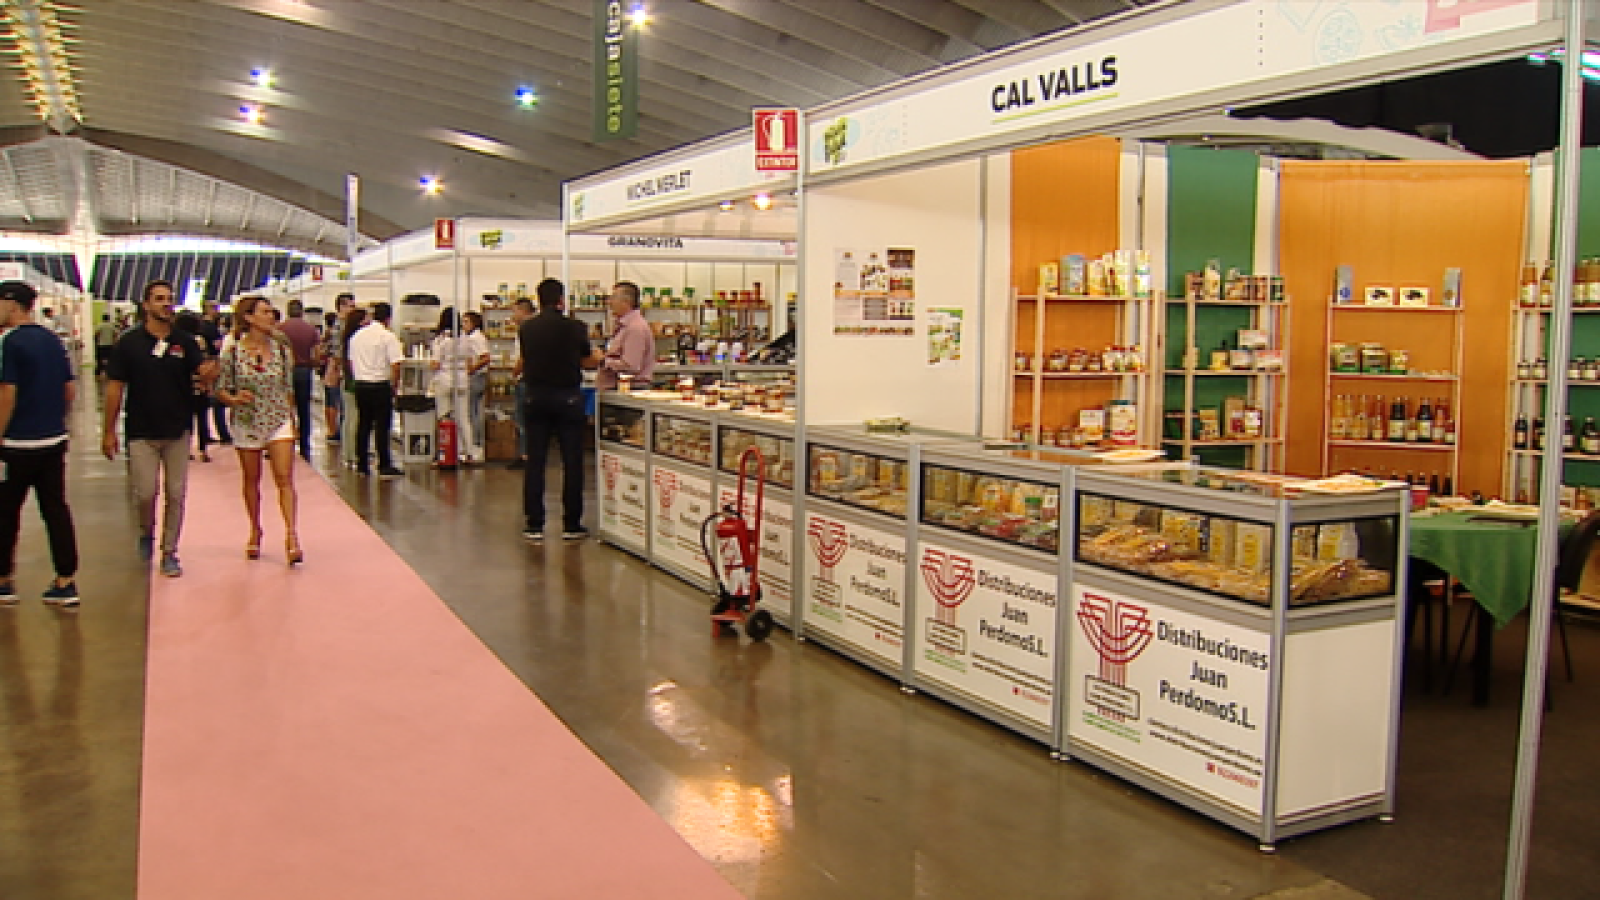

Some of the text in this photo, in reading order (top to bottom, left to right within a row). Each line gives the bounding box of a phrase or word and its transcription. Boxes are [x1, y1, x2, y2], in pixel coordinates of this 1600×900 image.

[991, 56, 1118, 113] CAL VALLS
[607, 236, 683, 248] GRANOVITA
[977, 569, 1056, 608] Distribuciones
[1001, 601, 1029, 626] Juan
[1157, 620, 1269, 671] Distribuciones
[1189, 660, 1229, 690] Juan
